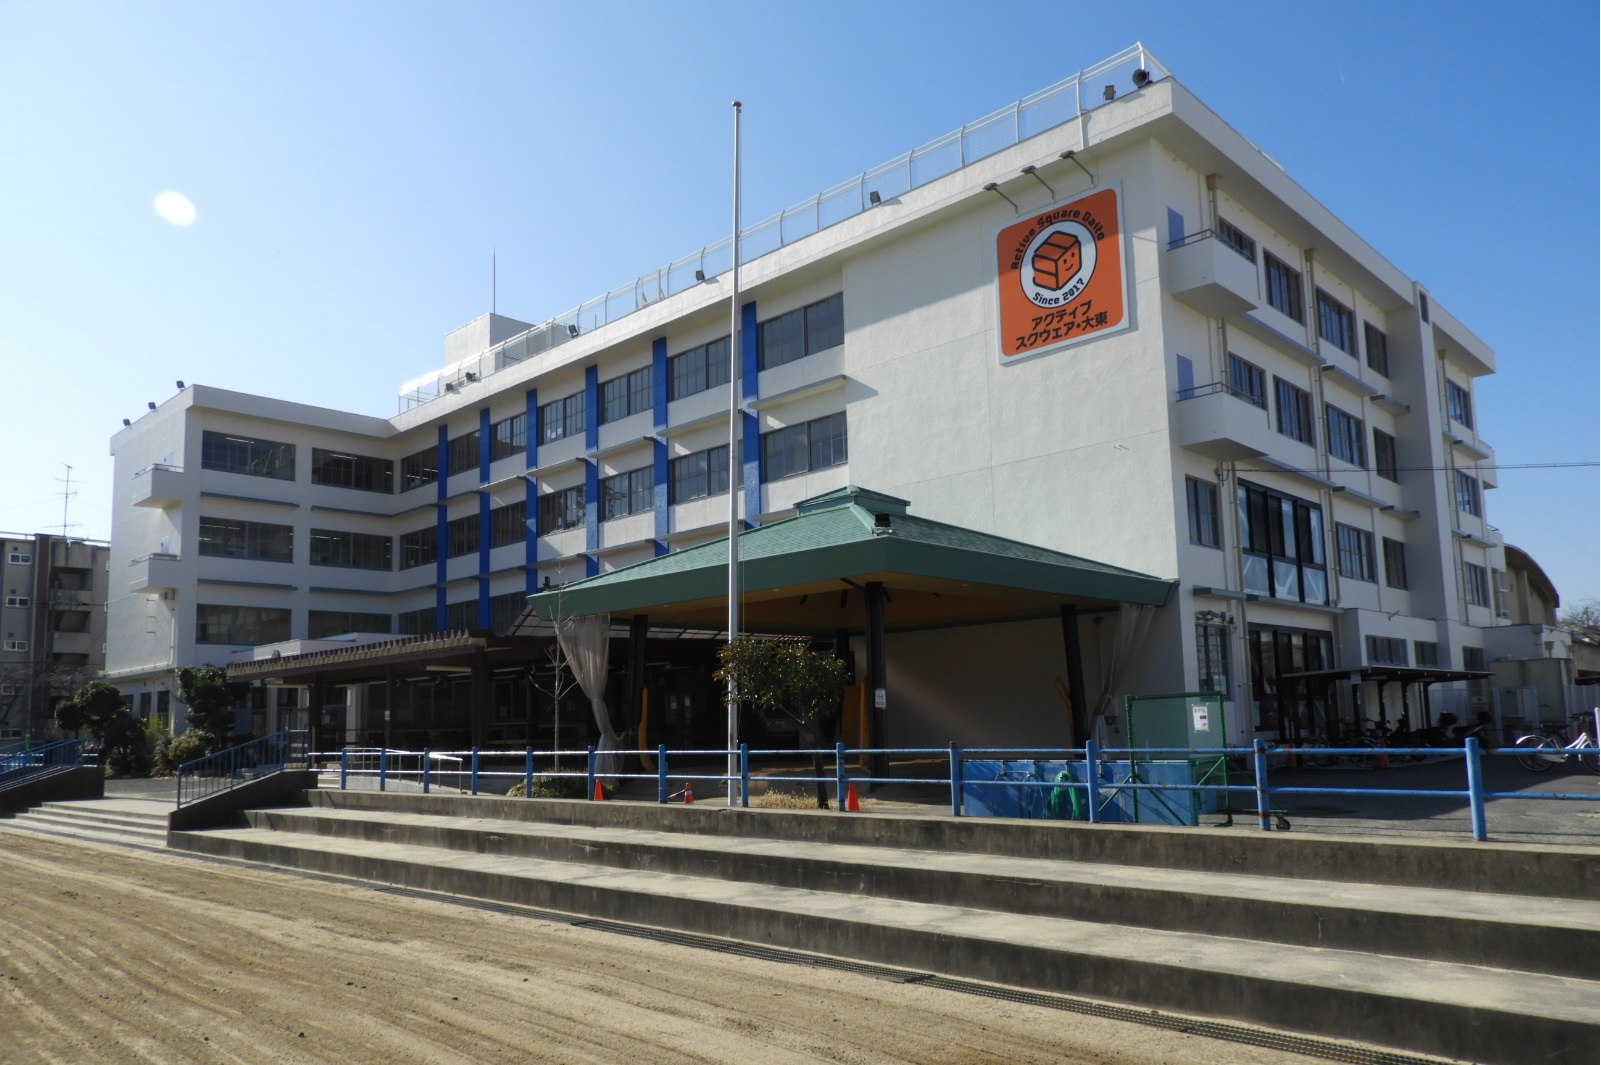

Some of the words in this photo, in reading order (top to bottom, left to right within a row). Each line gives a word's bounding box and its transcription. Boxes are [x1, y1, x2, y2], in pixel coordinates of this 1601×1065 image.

[1010, 229, 1036, 270] Active
[1037, 209, 1081, 229] Square
[1082, 211, 1105, 241] Daito
[1033, 292, 1060, 305] Since
[1063, 277, 1085, 302] 2017
